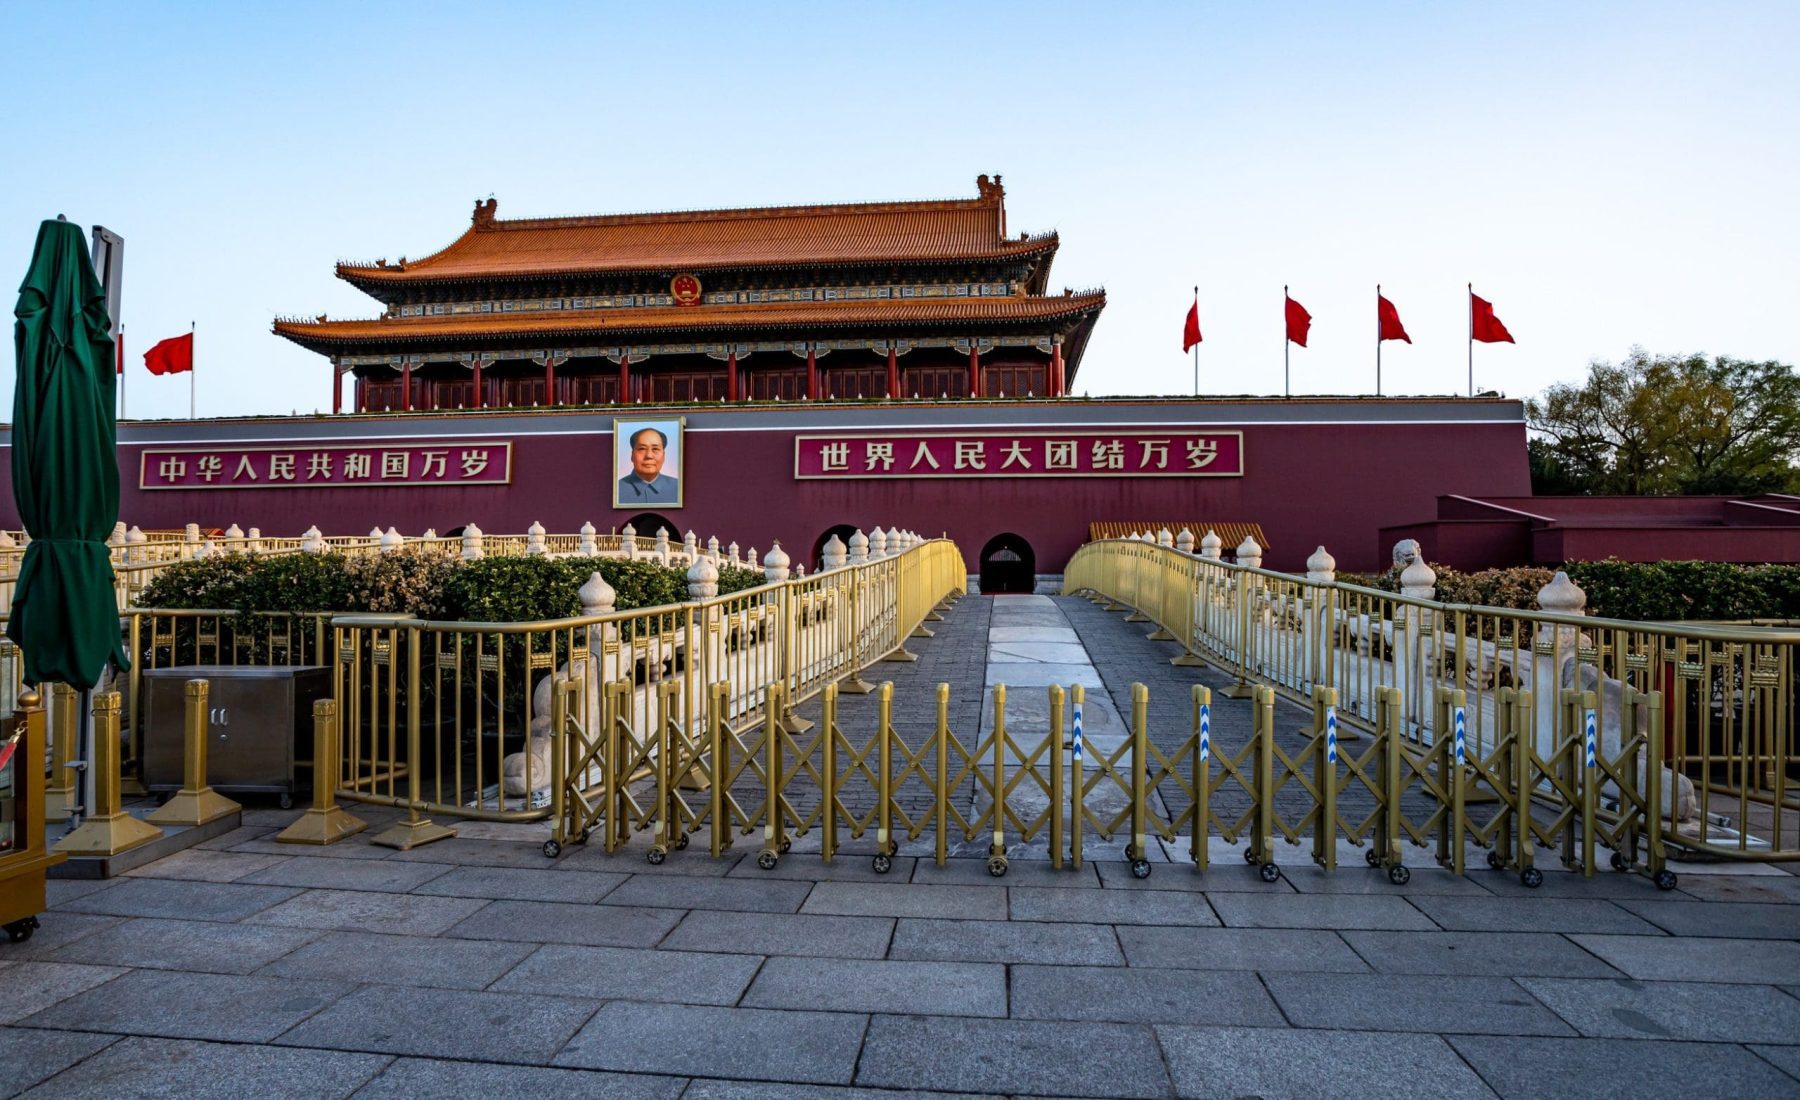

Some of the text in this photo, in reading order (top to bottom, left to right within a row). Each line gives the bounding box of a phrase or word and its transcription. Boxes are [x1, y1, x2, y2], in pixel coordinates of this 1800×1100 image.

[158, 450, 490, 482] 中华人民共和国万岁
[819, 439, 1219, 471] 世界人民大团结万岁
